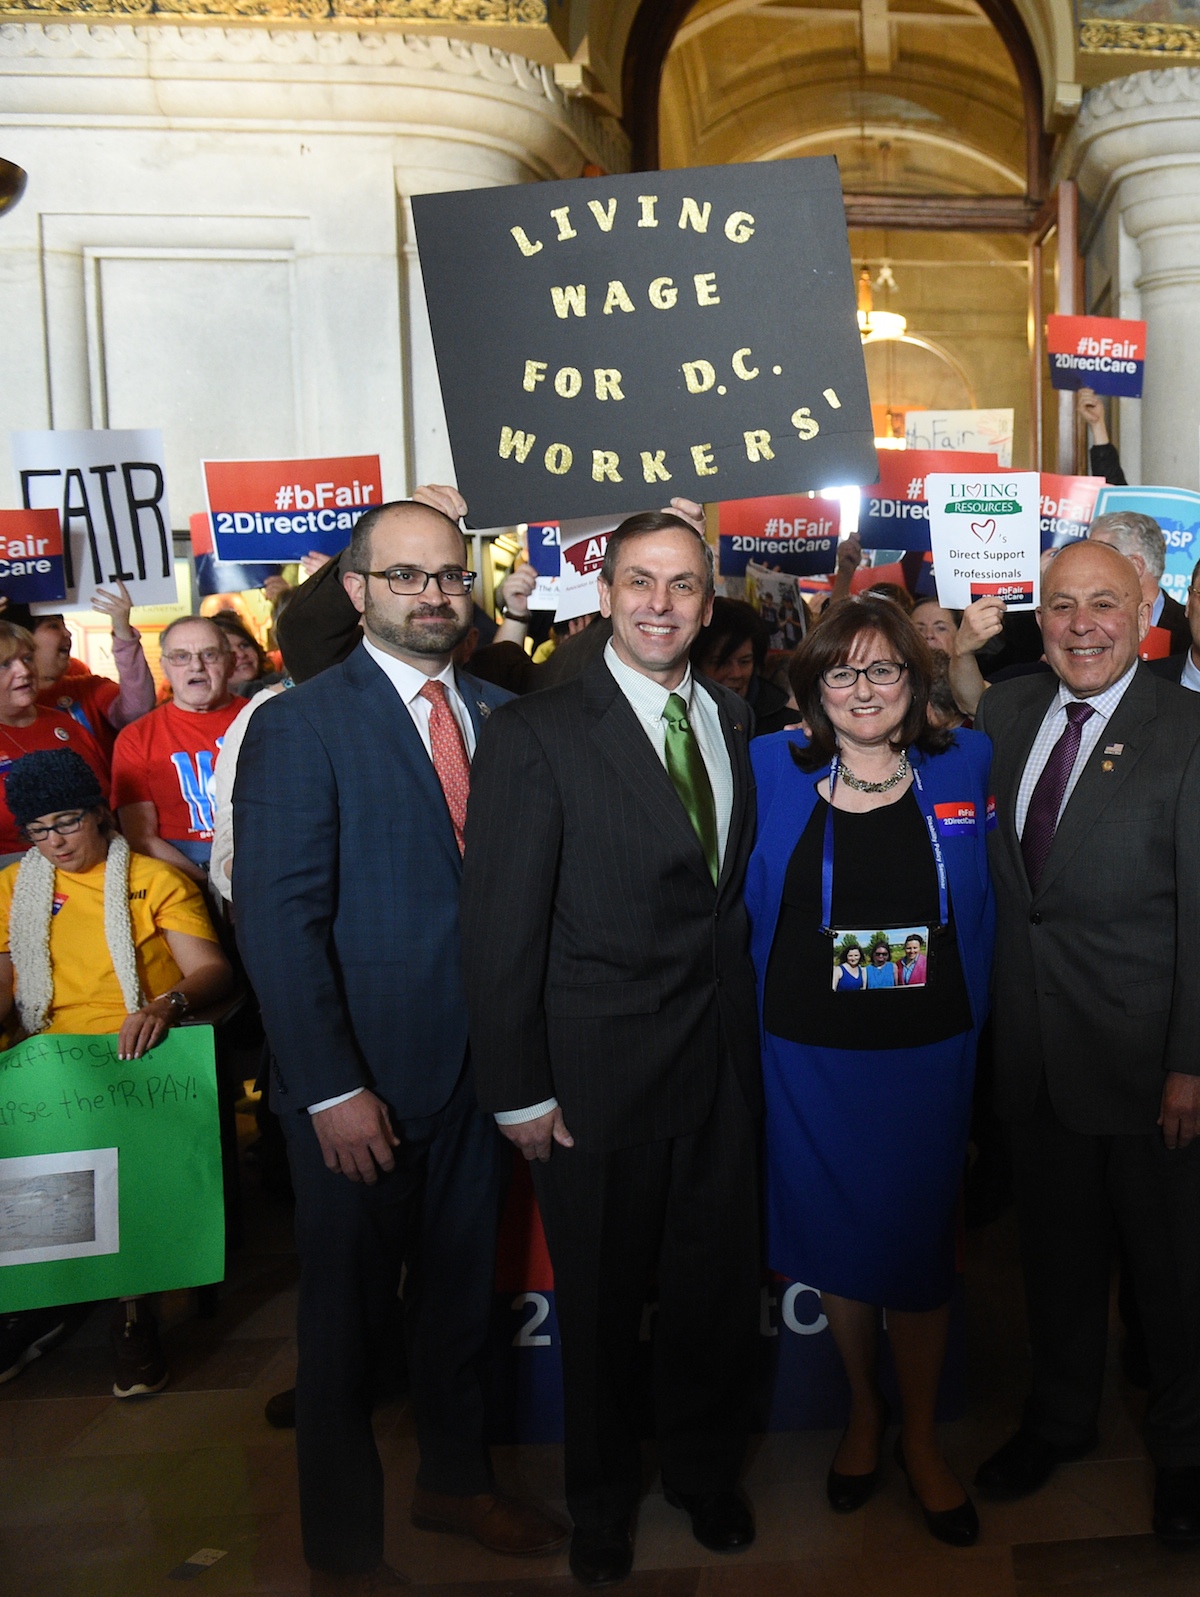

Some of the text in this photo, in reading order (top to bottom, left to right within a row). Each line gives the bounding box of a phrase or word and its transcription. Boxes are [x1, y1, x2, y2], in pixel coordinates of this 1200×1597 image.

[510, 195, 756, 257] LIVING
[550, 272, 721, 319] WAGE
[1076, 337, 1138, 359] #bFair
[522, 347, 783, 401] FOR D.C.
[1055, 353, 1137, 375] 2DirectCare
[274, 482, 375, 511] #bFair
[954, 501, 1013, 513] RESOURCES
[217, 508, 368, 536] 2DirectCar
[764, 518, 833, 539] #bFair
[731, 537, 831, 554] 2DirectCare
[950, 548, 1025, 562] Direct Support
[953, 568, 1022, 579] Professionals
[933, 842, 942, 863] Policy
